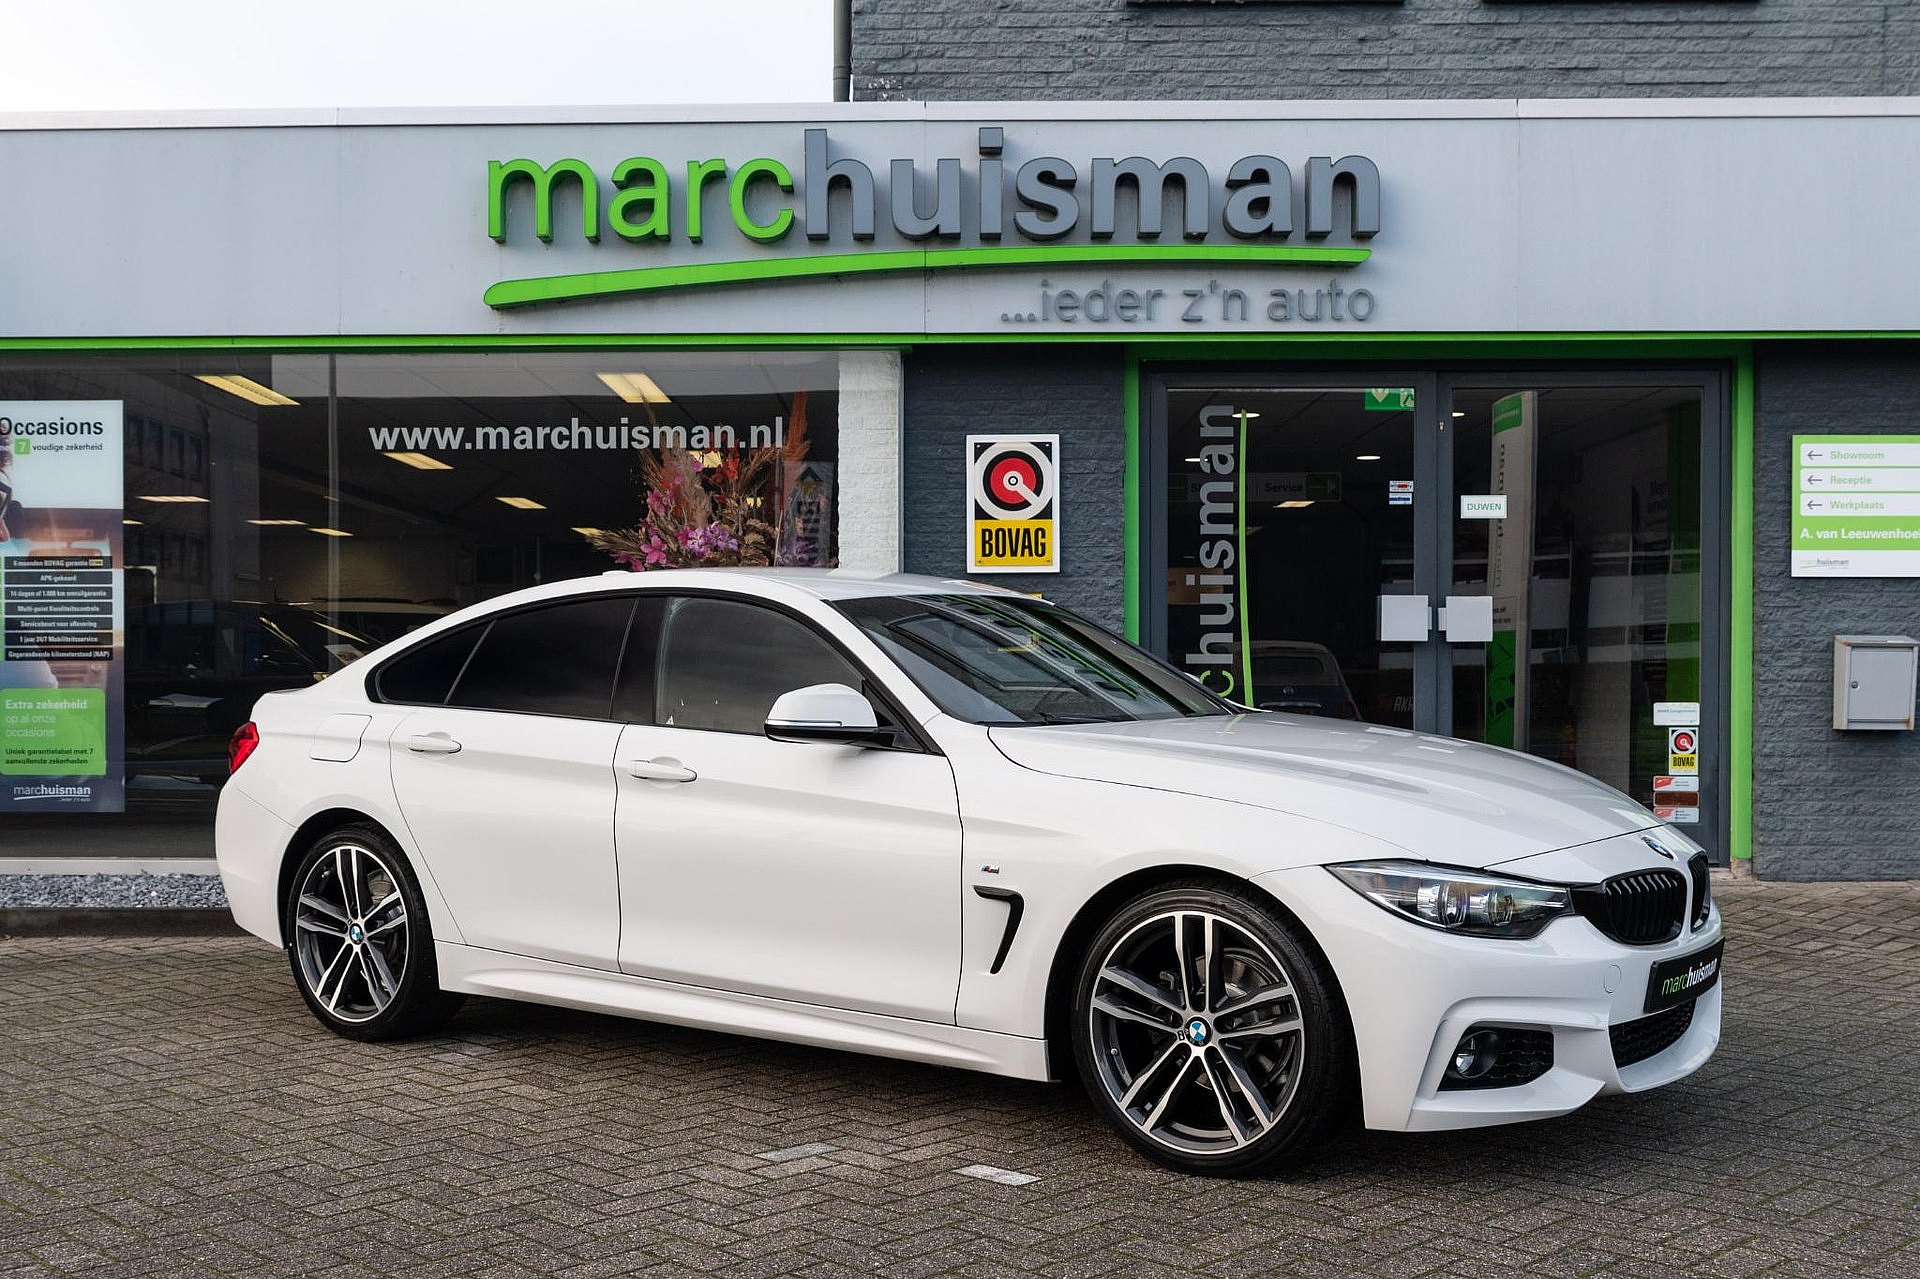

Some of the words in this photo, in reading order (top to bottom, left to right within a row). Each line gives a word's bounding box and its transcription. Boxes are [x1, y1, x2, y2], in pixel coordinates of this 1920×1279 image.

[487, 128, 1381, 244] marchuisman
[1000, 278, 1163, 322] ...ieder
[1181, 280, 1247, 322] z'n
[1267, 279, 1376, 321] auto
[0, 417, 103, 435] Occasions
[369, 417, 784, 451] www.marchuisman.nl
[18, 441, 26, 452] 7
[32, 443, 64, 452] voudige
[66, 443, 102, 451] zekerheid
[1830, 451, 1885, 460] Showroom
[1830, 476, 1872, 485] Receptie
[1467, 503, 1502, 511] DUWEN
[1830, 500, 1885, 511] Werkplaats
[1800, 529, 1813, 539] A.
[1816, 530, 1838, 539] van
[1841, 528, 1920, 539] Leeuwenhoe
[981, 528, 1046, 557] BOVAG
[5, 699, 34, 709] Extra
[36, 699, 88, 709] zekerheid
[5, 728, 55, 737] occasions
[1672, 756, 1695, 766] BOVAG
[13, 784, 91, 795] marchuisman
[1661, 957, 1718, 996] marchuisman
